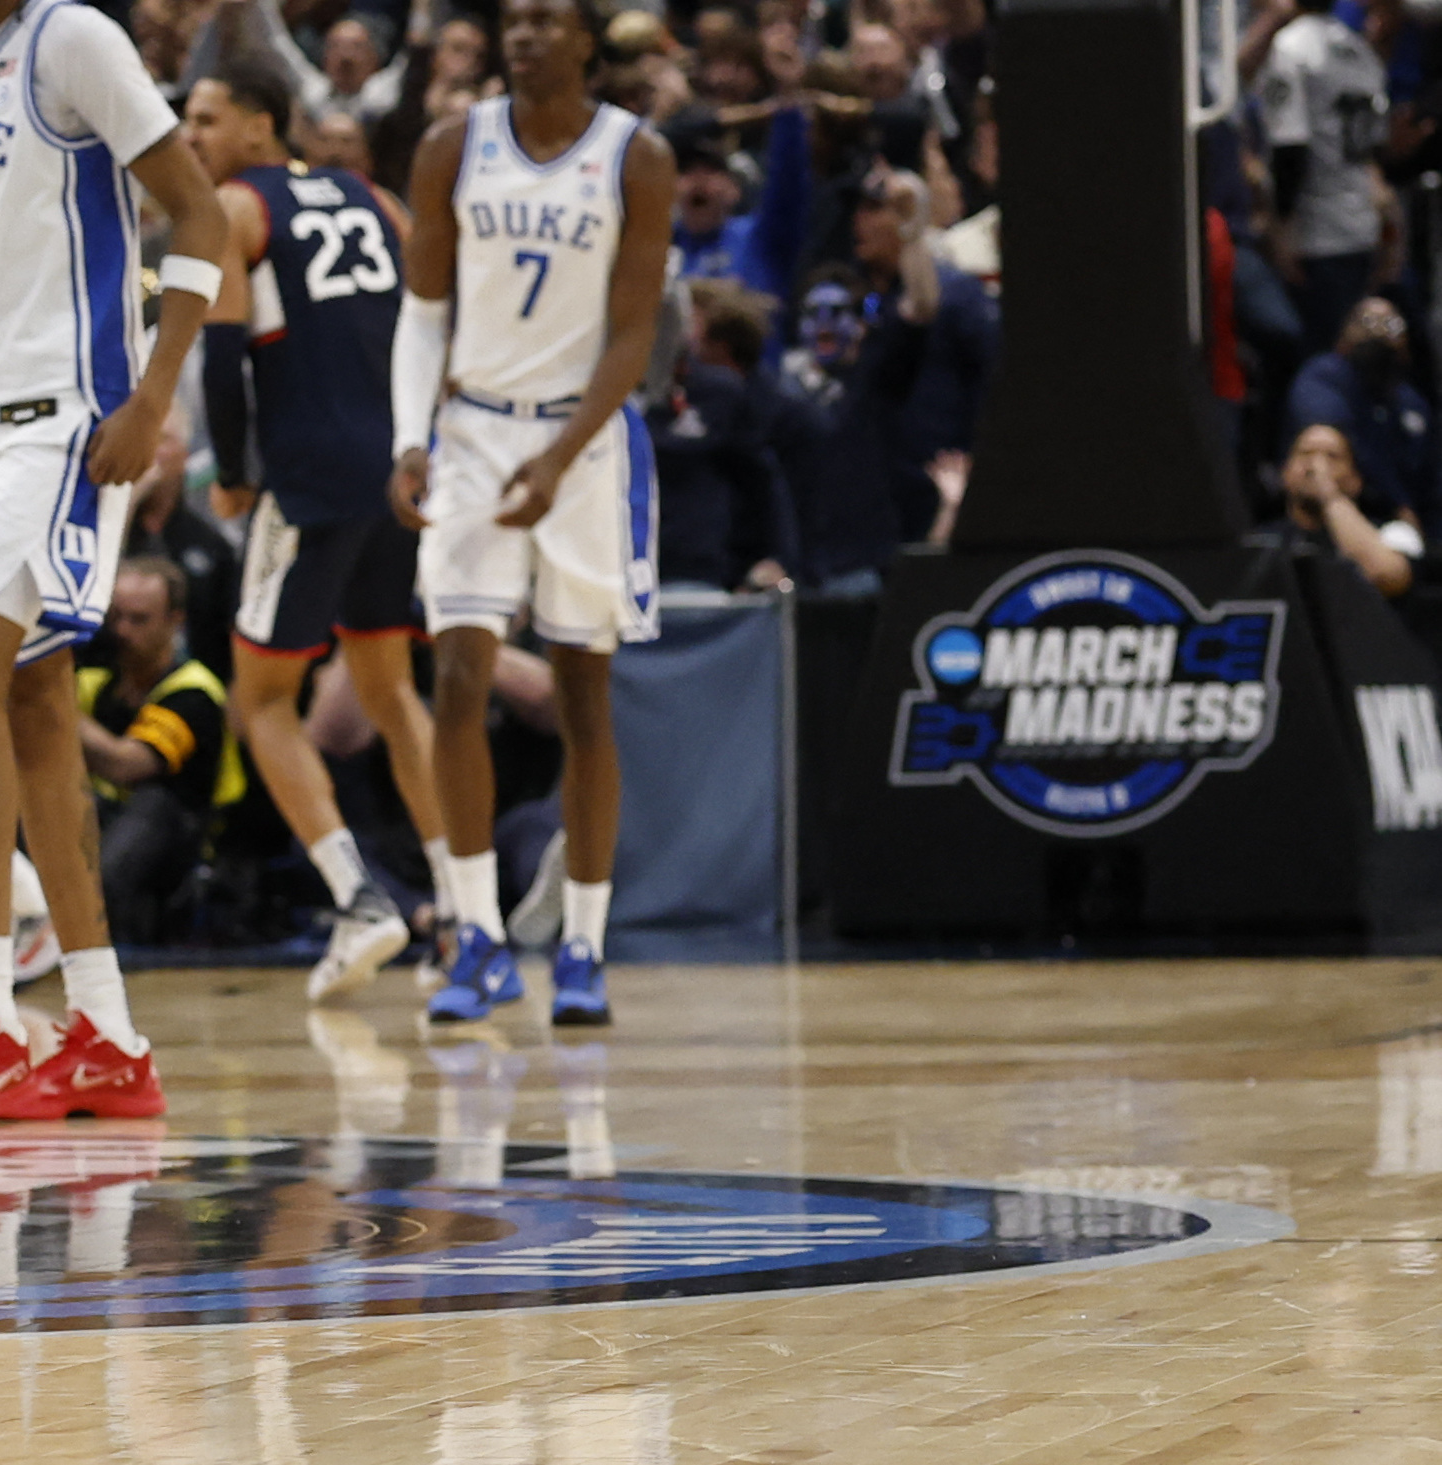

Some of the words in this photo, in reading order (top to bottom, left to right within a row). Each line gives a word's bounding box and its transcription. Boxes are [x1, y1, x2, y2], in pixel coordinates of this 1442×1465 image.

[289, 207, 398, 302] 23
[471, 200, 601, 250] DUKE
[515, 249, 549, 318] 7
[981, 625, 1178, 686] MARCH
[1003, 681, 1266, 746] MADNESS
